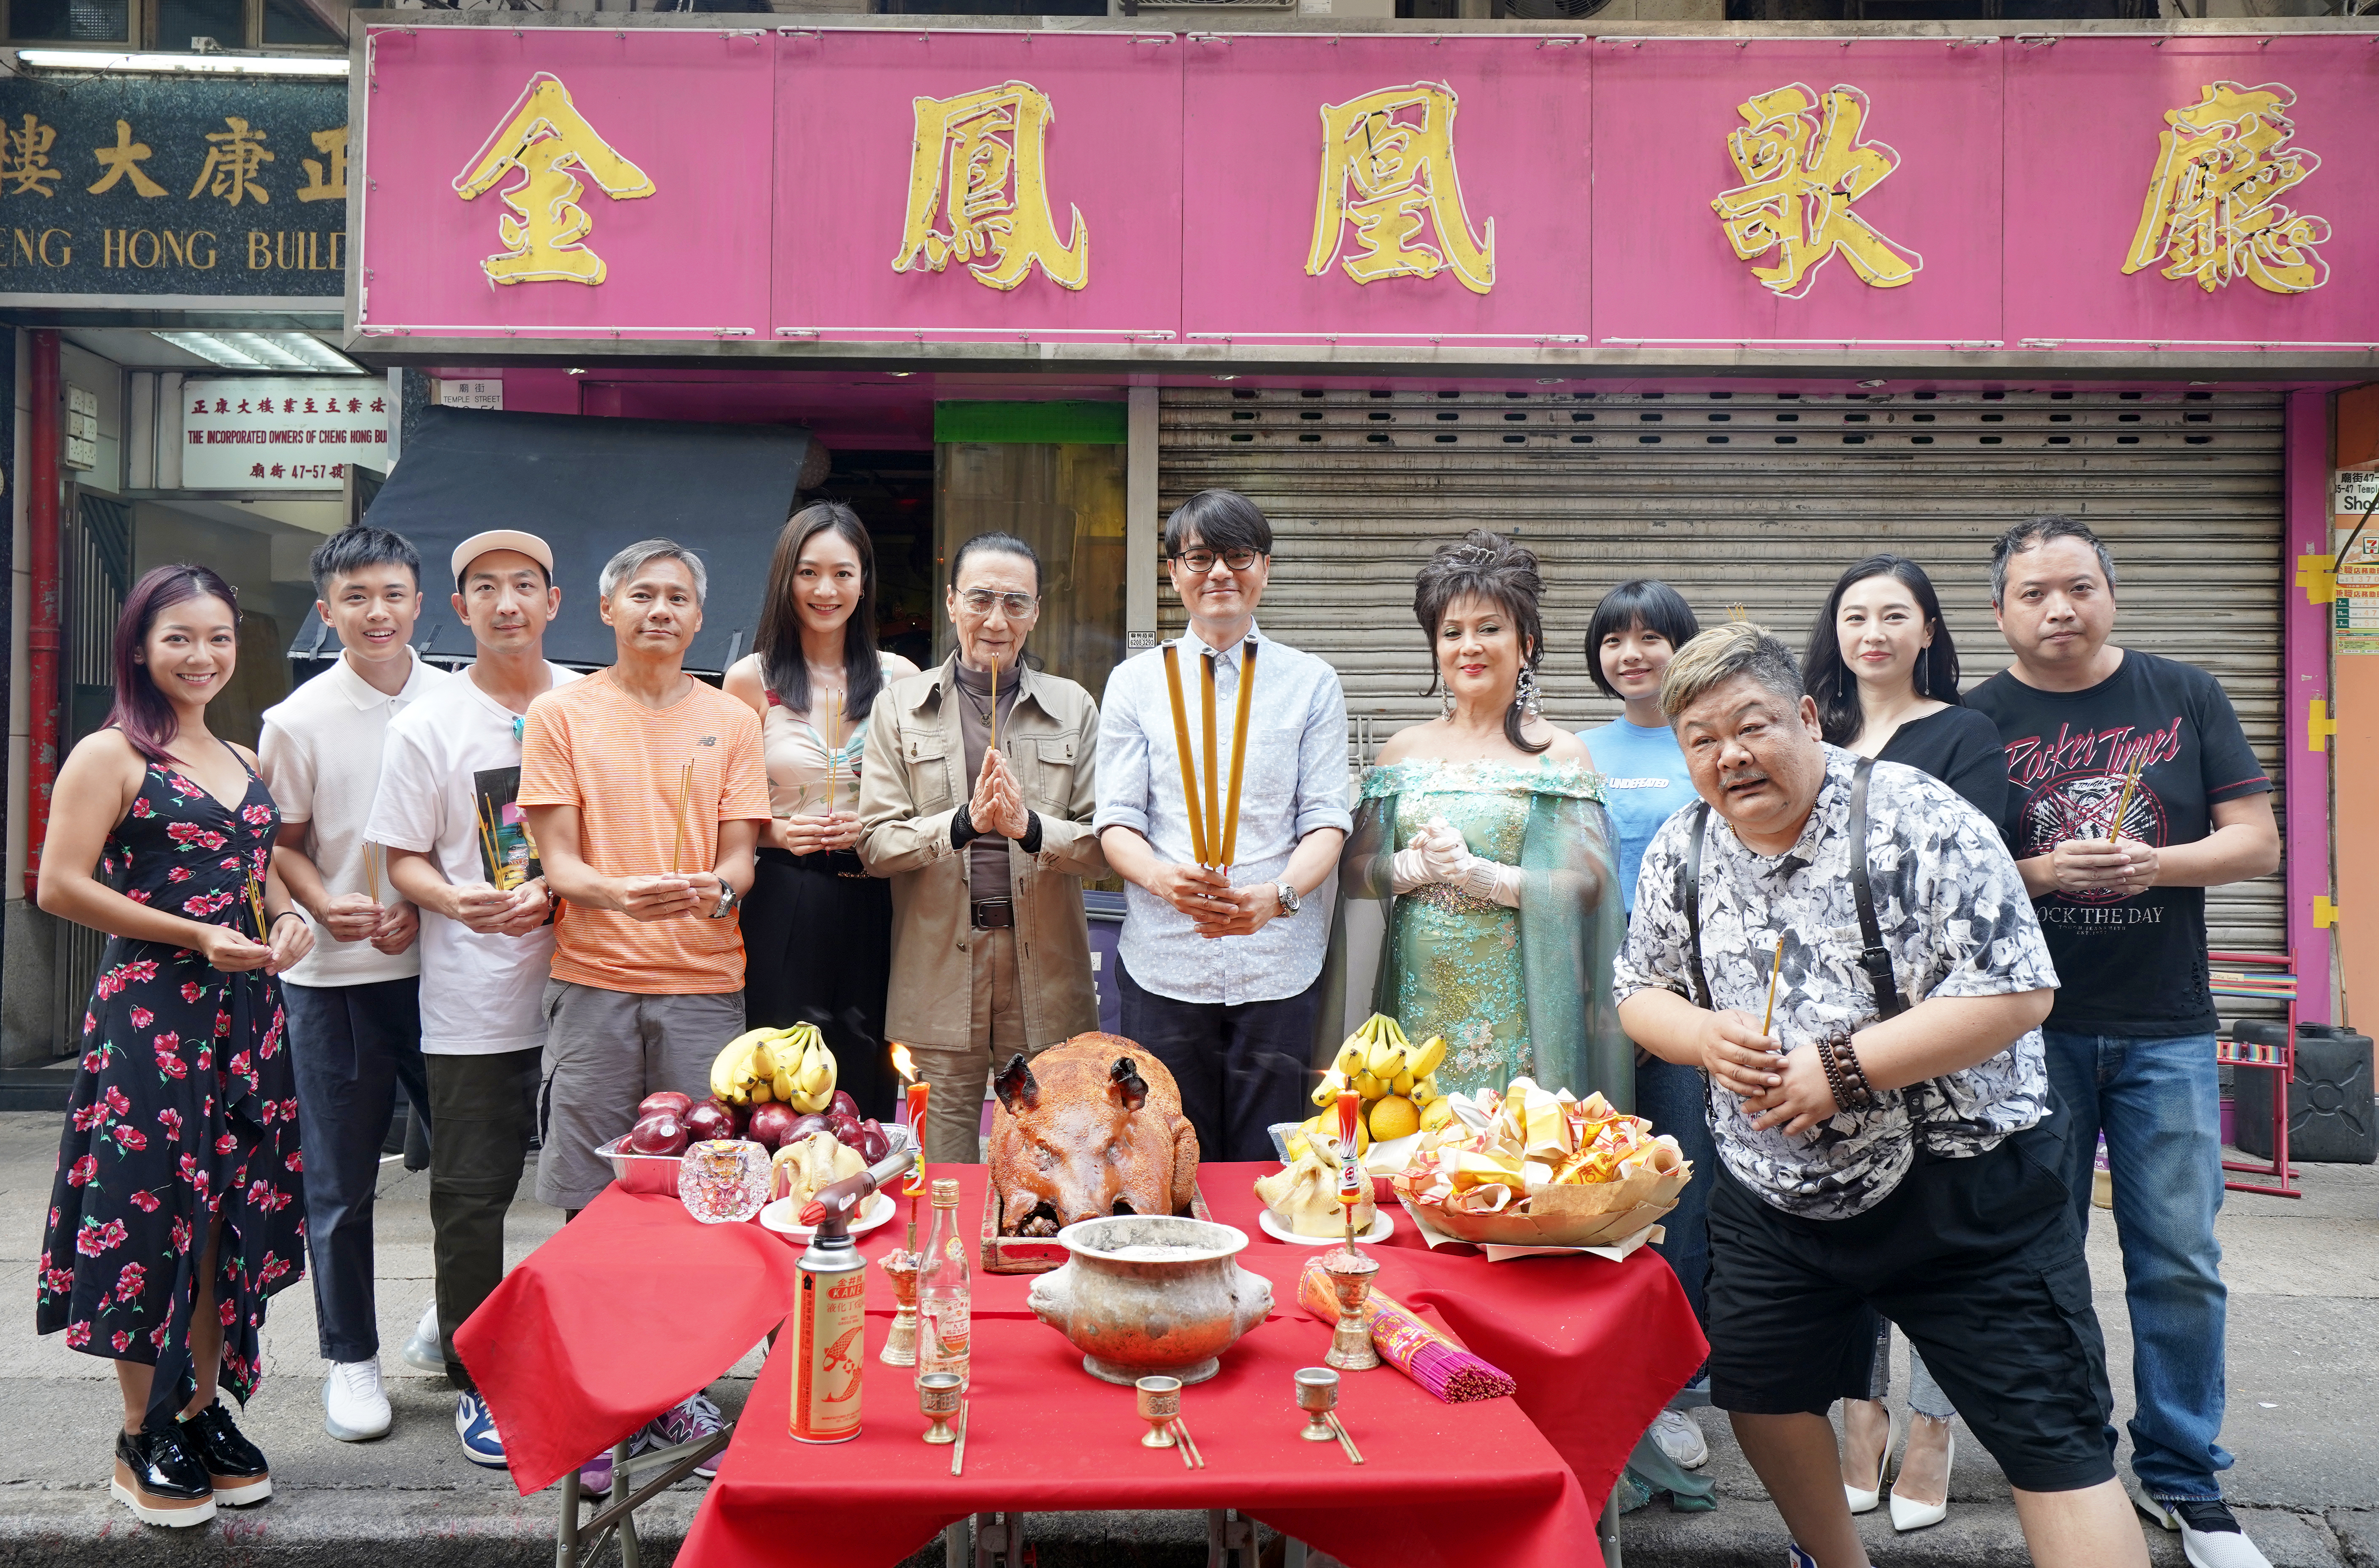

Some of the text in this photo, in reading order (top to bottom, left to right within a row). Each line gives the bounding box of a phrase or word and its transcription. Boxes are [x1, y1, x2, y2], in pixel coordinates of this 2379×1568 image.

[453, 70, 2331, 300] 金鳳凰歌廳
[103, 229, 217, 270] HONG
[459, 383, 484, 393] 廟街
[188, 430, 204, 444] THE
[207, 430, 266, 444] INCORPORATED
[269, 430, 303, 443] OWNERS
[306, 430, 316, 443] OF
[319, 430, 347, 443] CHENG
[350, 430, 372, 443] HONG
[1609, 777, 1670, 789] UNDEFEATED
[2036, 906, 2164, 924] OCK THE DAY
